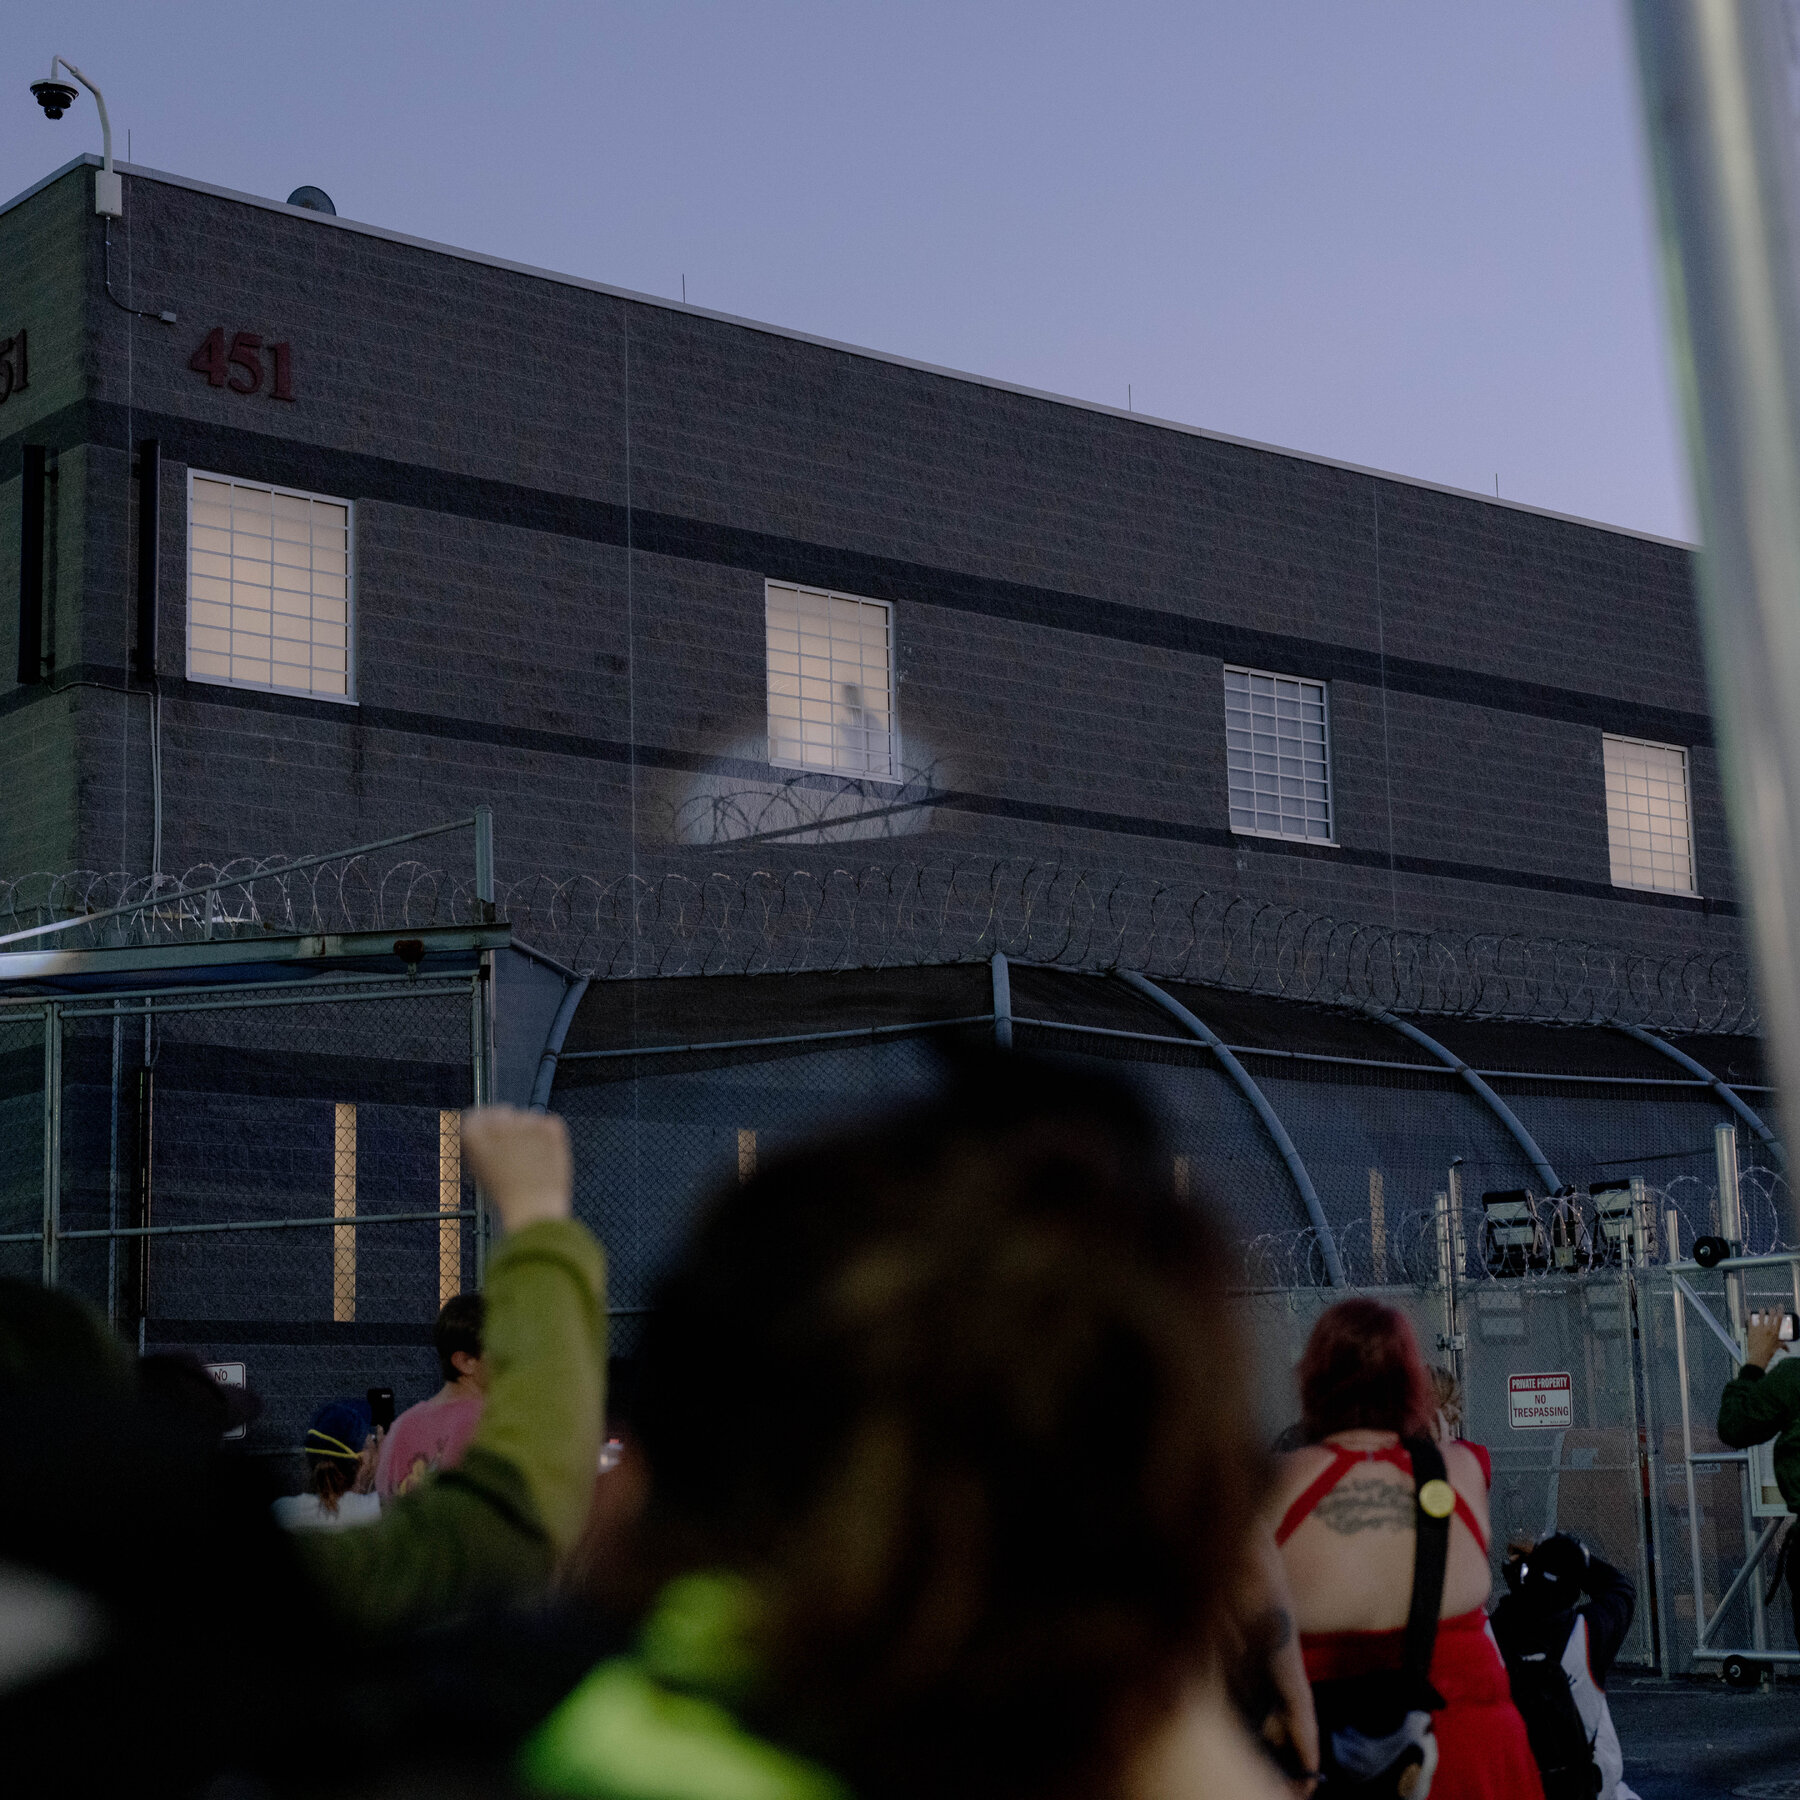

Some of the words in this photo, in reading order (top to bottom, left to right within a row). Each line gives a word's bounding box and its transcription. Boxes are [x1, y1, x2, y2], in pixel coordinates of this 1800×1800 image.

[188, 326, 296, 402] 451
[214, 1370, 228, 1381] NO
[1511, 1378, 1536, 1390] PRIVATE
[1537, 1376, 1567, 1389] PROPERTY
[1534, 1394, 1547, 1405] NO
[1513, 1406, 1569, 1418] TRESPASSING
